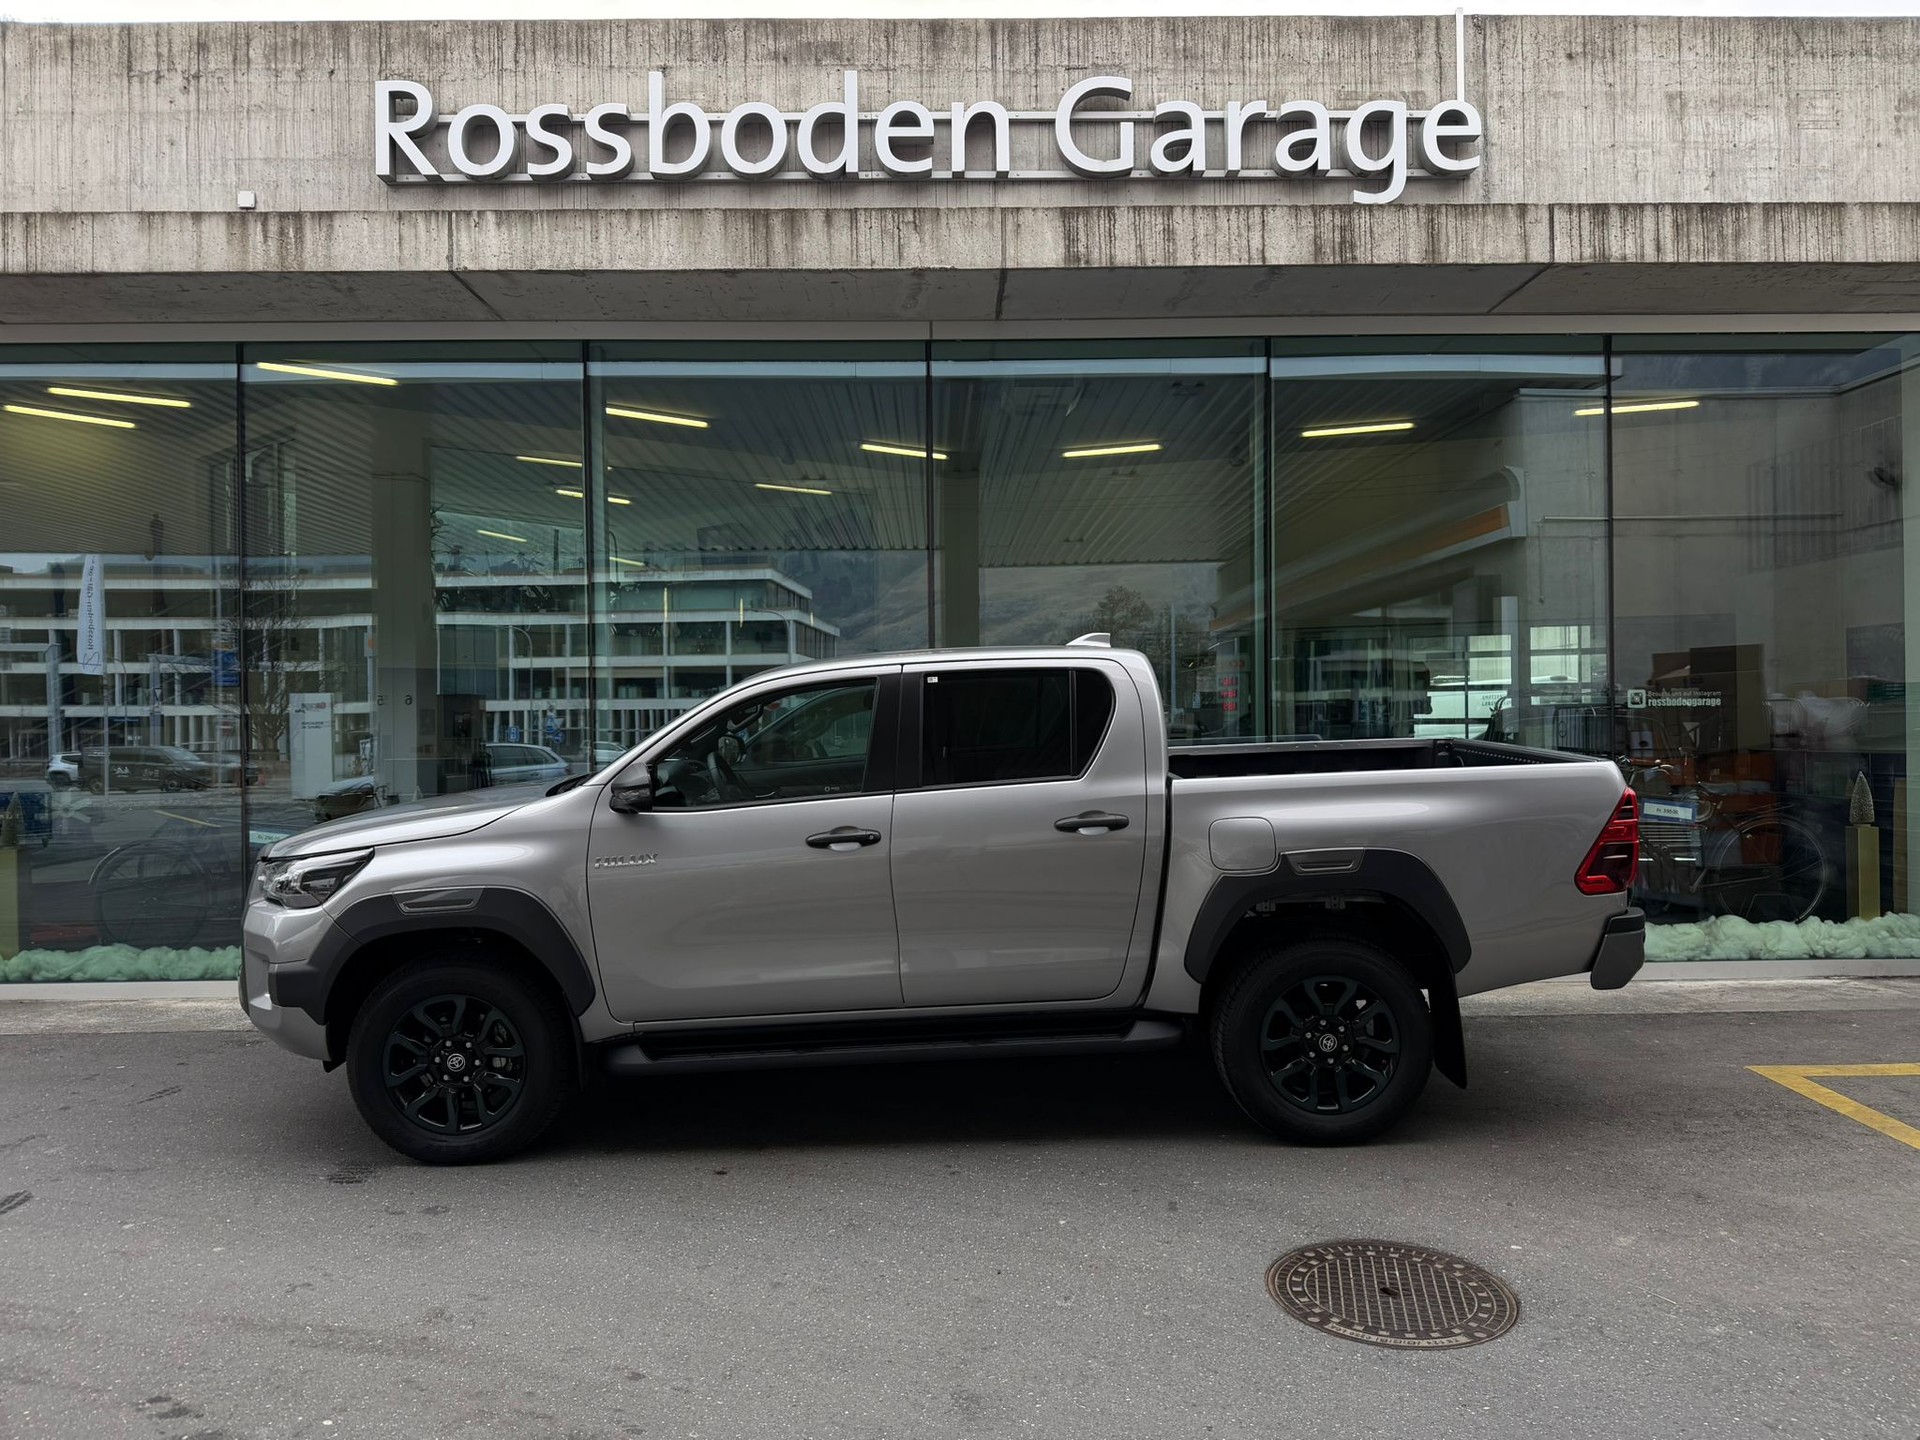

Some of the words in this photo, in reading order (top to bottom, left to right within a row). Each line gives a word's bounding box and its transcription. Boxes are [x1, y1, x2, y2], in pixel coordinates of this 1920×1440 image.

[374, 71, 1010, 180] Rossboden
[1055, 76, 1482, 204] Garage
[594, 853, 658, 869] HILUX
